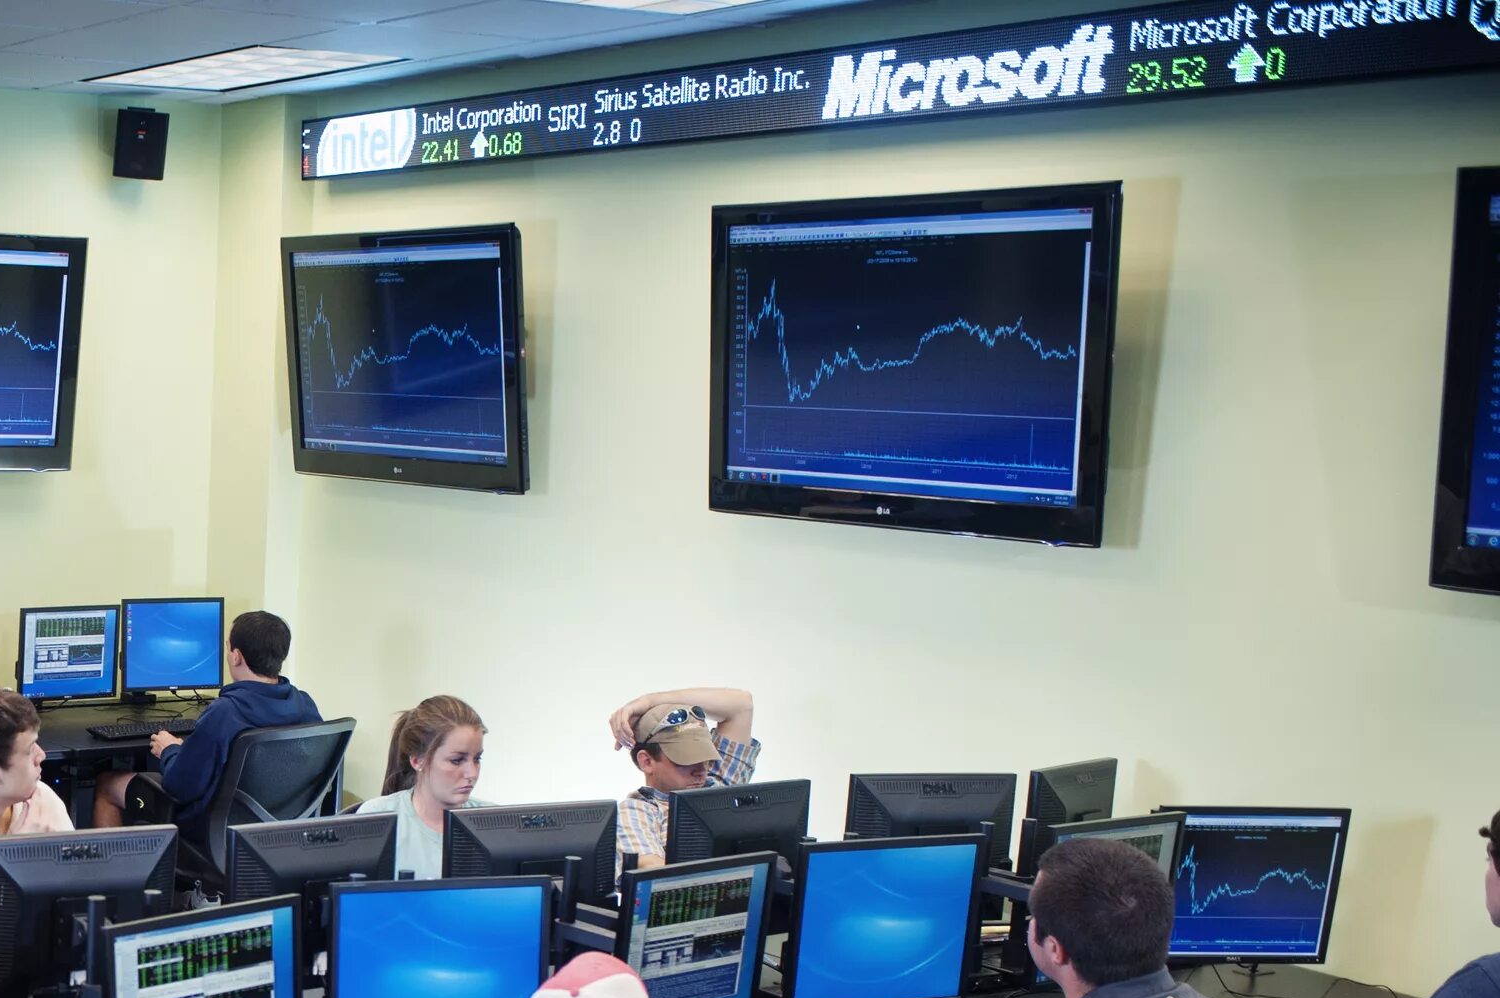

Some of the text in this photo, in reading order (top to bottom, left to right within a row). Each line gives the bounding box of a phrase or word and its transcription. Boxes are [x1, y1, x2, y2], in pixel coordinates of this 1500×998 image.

[1130, 2, 1259, 52] Microsoft
[594, 67, 810, 114] Sirius Satellite Radio Inc.
[821, 23, 1115, 121] Microsoft
[1126, 56, 1208, 94] 29.52
[422, 101, 541, 134] Intel Corporation
[548, 103, 587, 132] SIRI
[593, 120, 621, 146] 2.8
[332, 112, 398, 170] intel
[421, 132, 522, 164] 22.41 0.68
